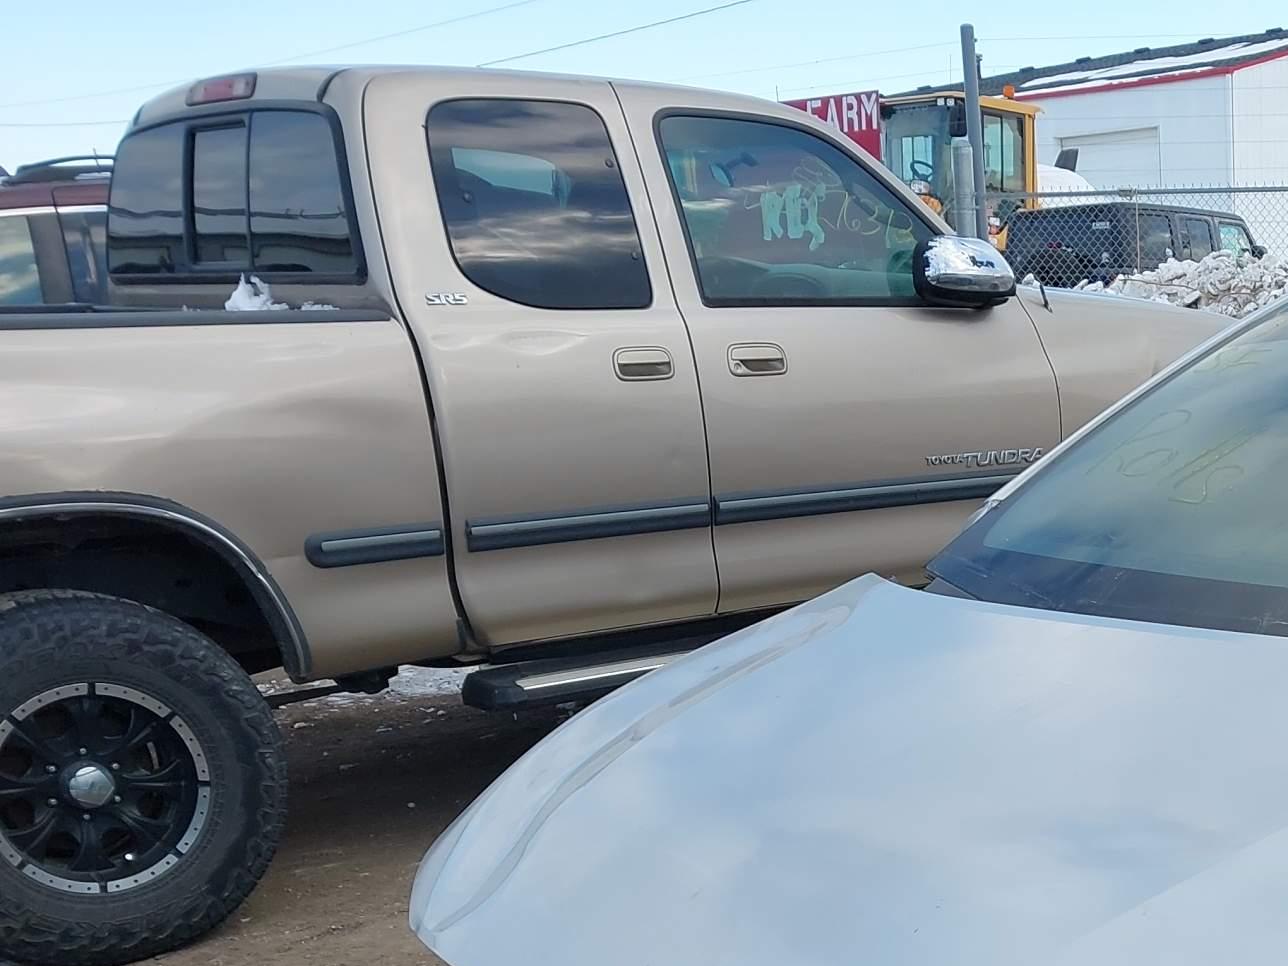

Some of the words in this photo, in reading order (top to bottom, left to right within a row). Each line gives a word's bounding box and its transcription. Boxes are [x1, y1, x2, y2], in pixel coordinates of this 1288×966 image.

[425, 292, 468, 305] SR5
[926, 454, 963, 466] TOYOTA
[963, 447, 1044, 468] TUNDRA
